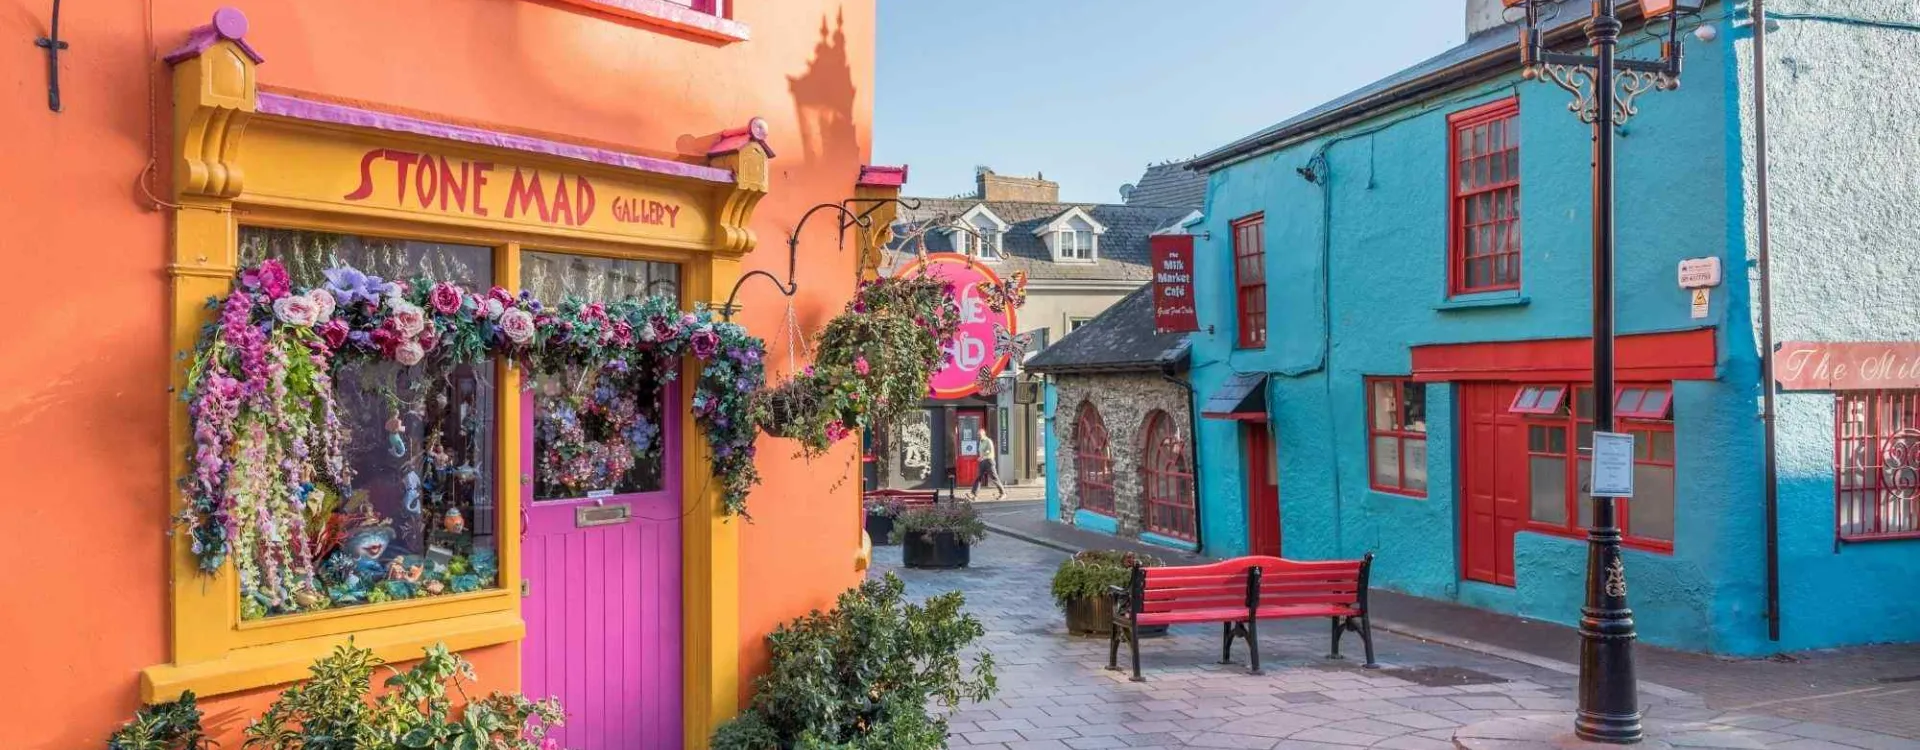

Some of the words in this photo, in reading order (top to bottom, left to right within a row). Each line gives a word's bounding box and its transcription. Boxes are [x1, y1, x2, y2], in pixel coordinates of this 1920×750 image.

[344, 148, 494, 217] STONE
[504, 166, 596, 226] MAD
[611, 196, 681, 229] GALLERY
[1157, 273, 1190, 283] Market
[1163, 260, 1184, 270] Milk
[940, 331, 986, 372] AD
[1783, 349, 1847, 381] The
